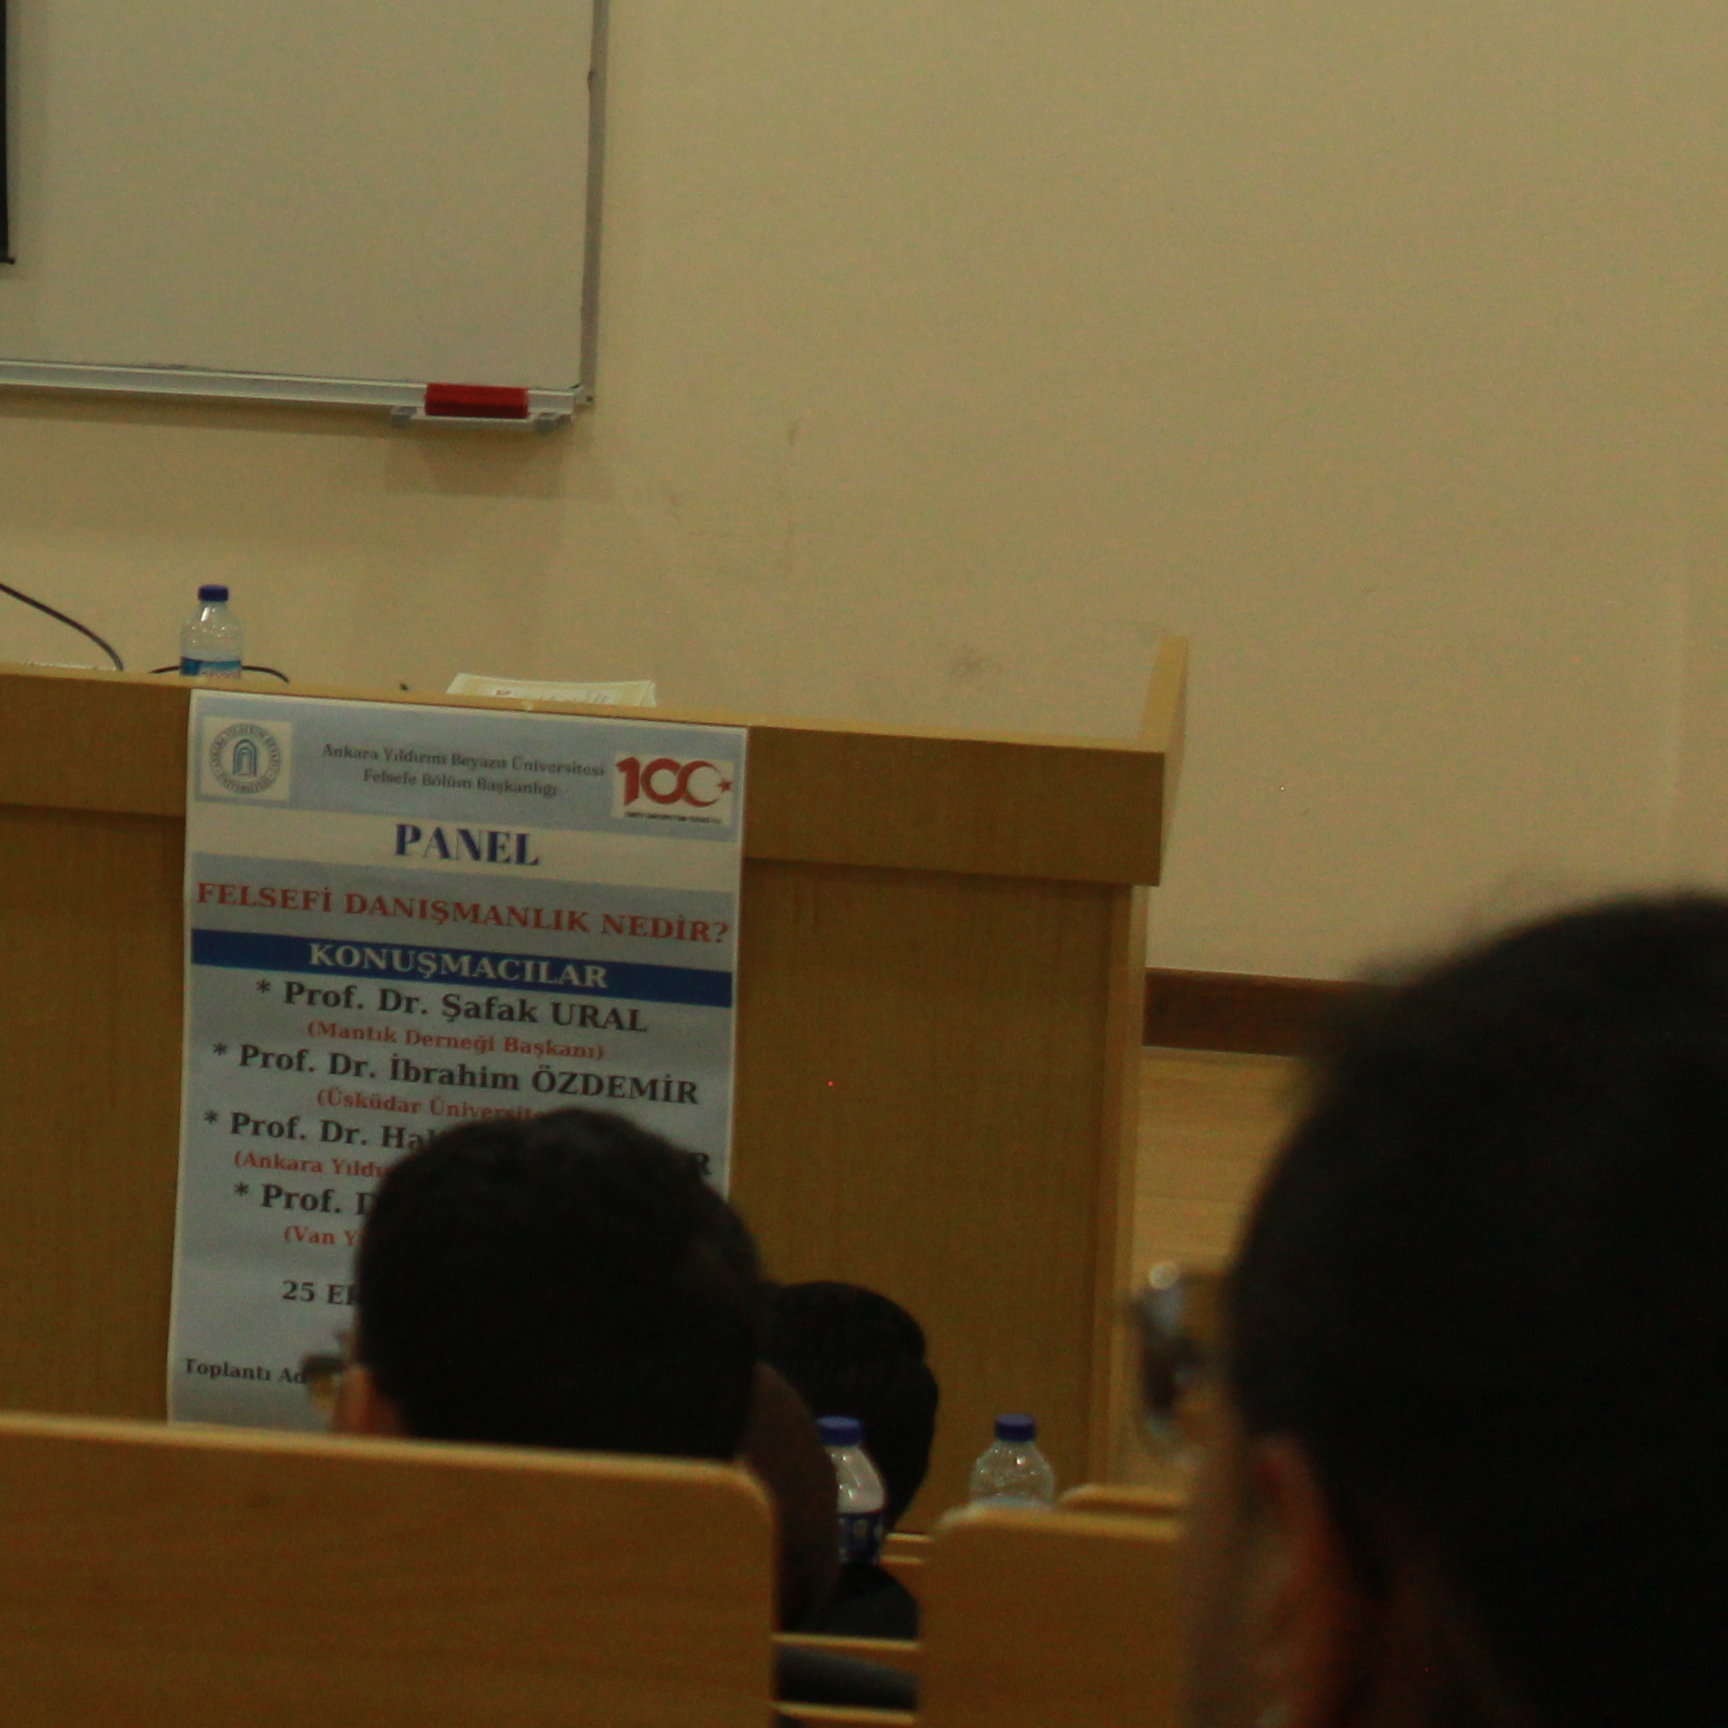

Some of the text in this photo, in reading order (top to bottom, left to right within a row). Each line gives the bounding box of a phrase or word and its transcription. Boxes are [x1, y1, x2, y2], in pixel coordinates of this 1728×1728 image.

[322, 743, 378, 761] Ankara
[384, 748, 445, 765] Yıldırım
[512, 755, 604, 776] Üniversitesi
[363, 768, 417, 785] Felsefe
[422, 771, 471, 789] Bölüm
[395, 823, 539, 866] PANEL
[197, 882, 728, 943] FELSEFİ DANIŞMANLIK NEDİR?
[309, 942, 607, 988] KONUŞMACILAR
[284, 981, 647, 1032] Prof. Dr. Şafak URAL
[307, 1020, 604, 1060] (Mantık Derneği Başkanı)
[239, 1043, 698, 1104] Prof. Dr. İbrahim ÖZDEMİR
[317, 1086, 421, 1114] (Üsküdar
[231, 1111, 306, 1140] Prof.
[320, 1119, 367, 1146] Dr.
[234, 1150, 323, 1173] (Ankara
[261, 1183, 341, 1214] Prof.
[283, 1226, 336, 1246] (Van
[282, 1280, 315, 1302] 25
[185, 1358, 270, 1381] Toplantı
